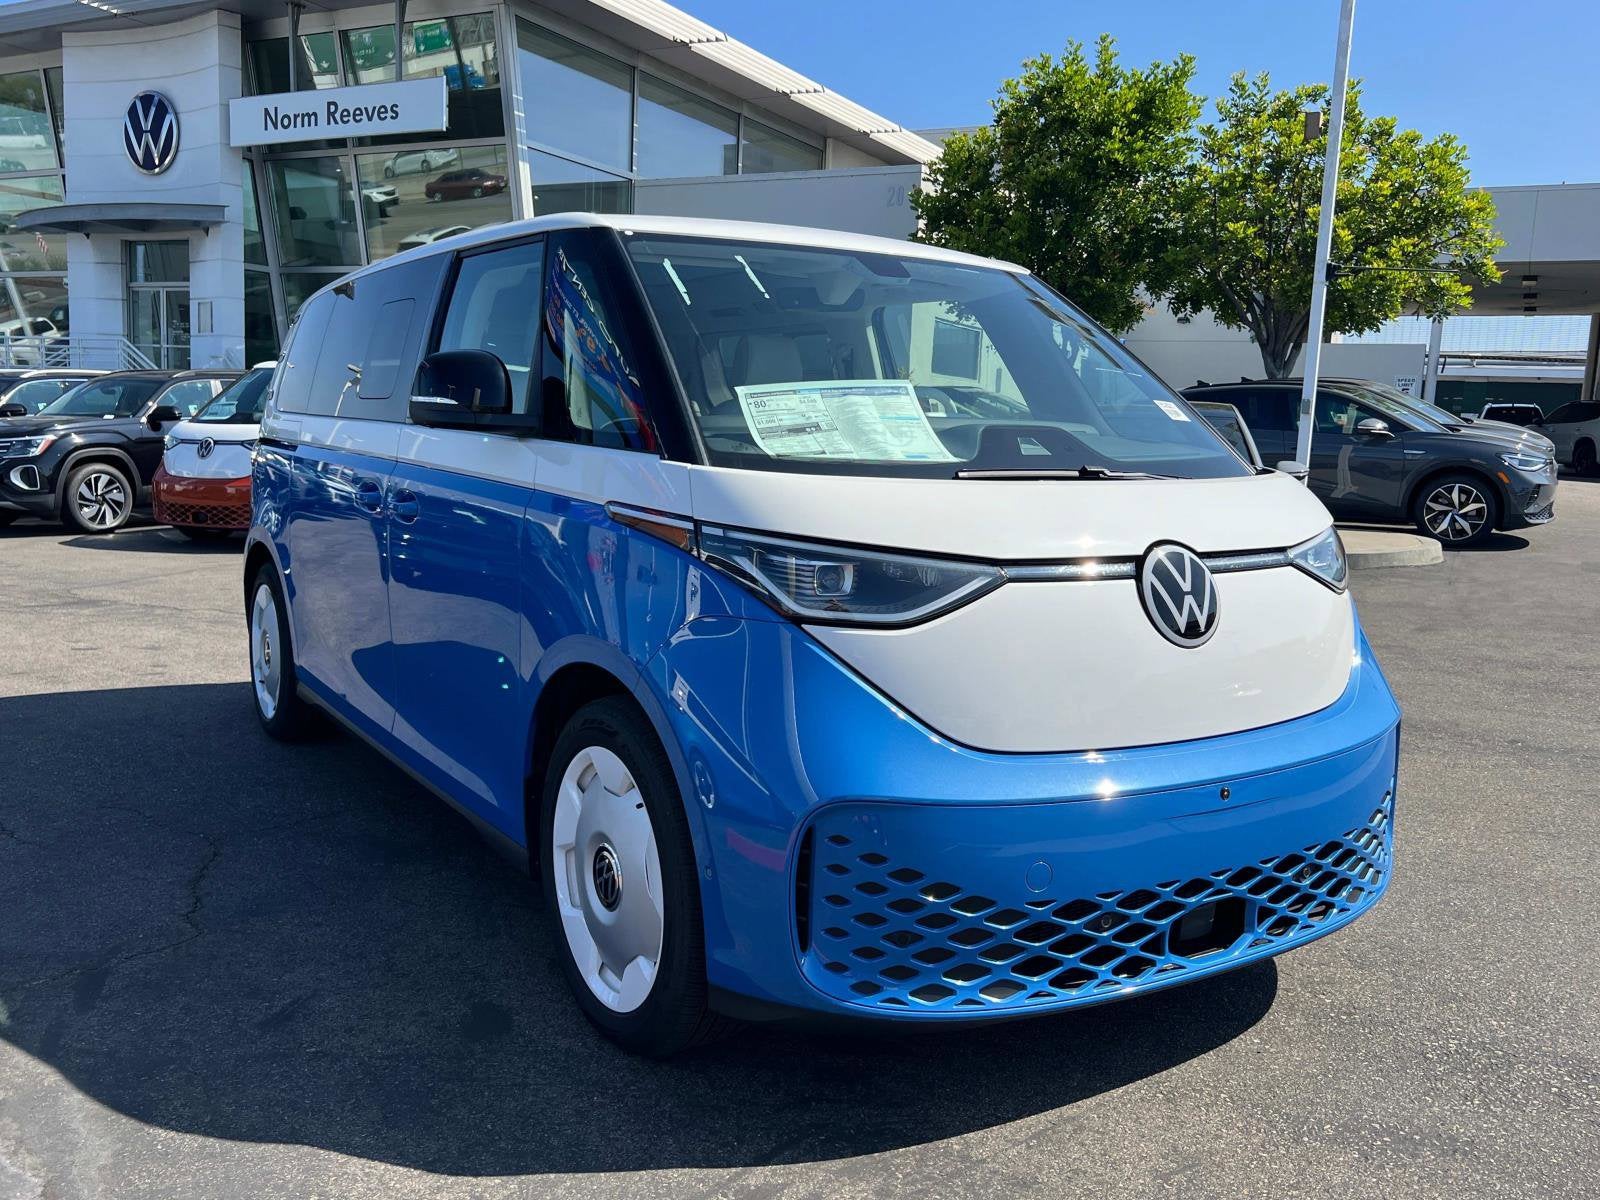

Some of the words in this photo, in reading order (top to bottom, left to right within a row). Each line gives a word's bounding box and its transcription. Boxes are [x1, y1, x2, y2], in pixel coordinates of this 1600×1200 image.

[263, 106, 319, 131] Norm
[326, 101, 399, 126] Reeves
[753, 400, 767, 409] 80
[1144, 547, 1218, 642] VW
